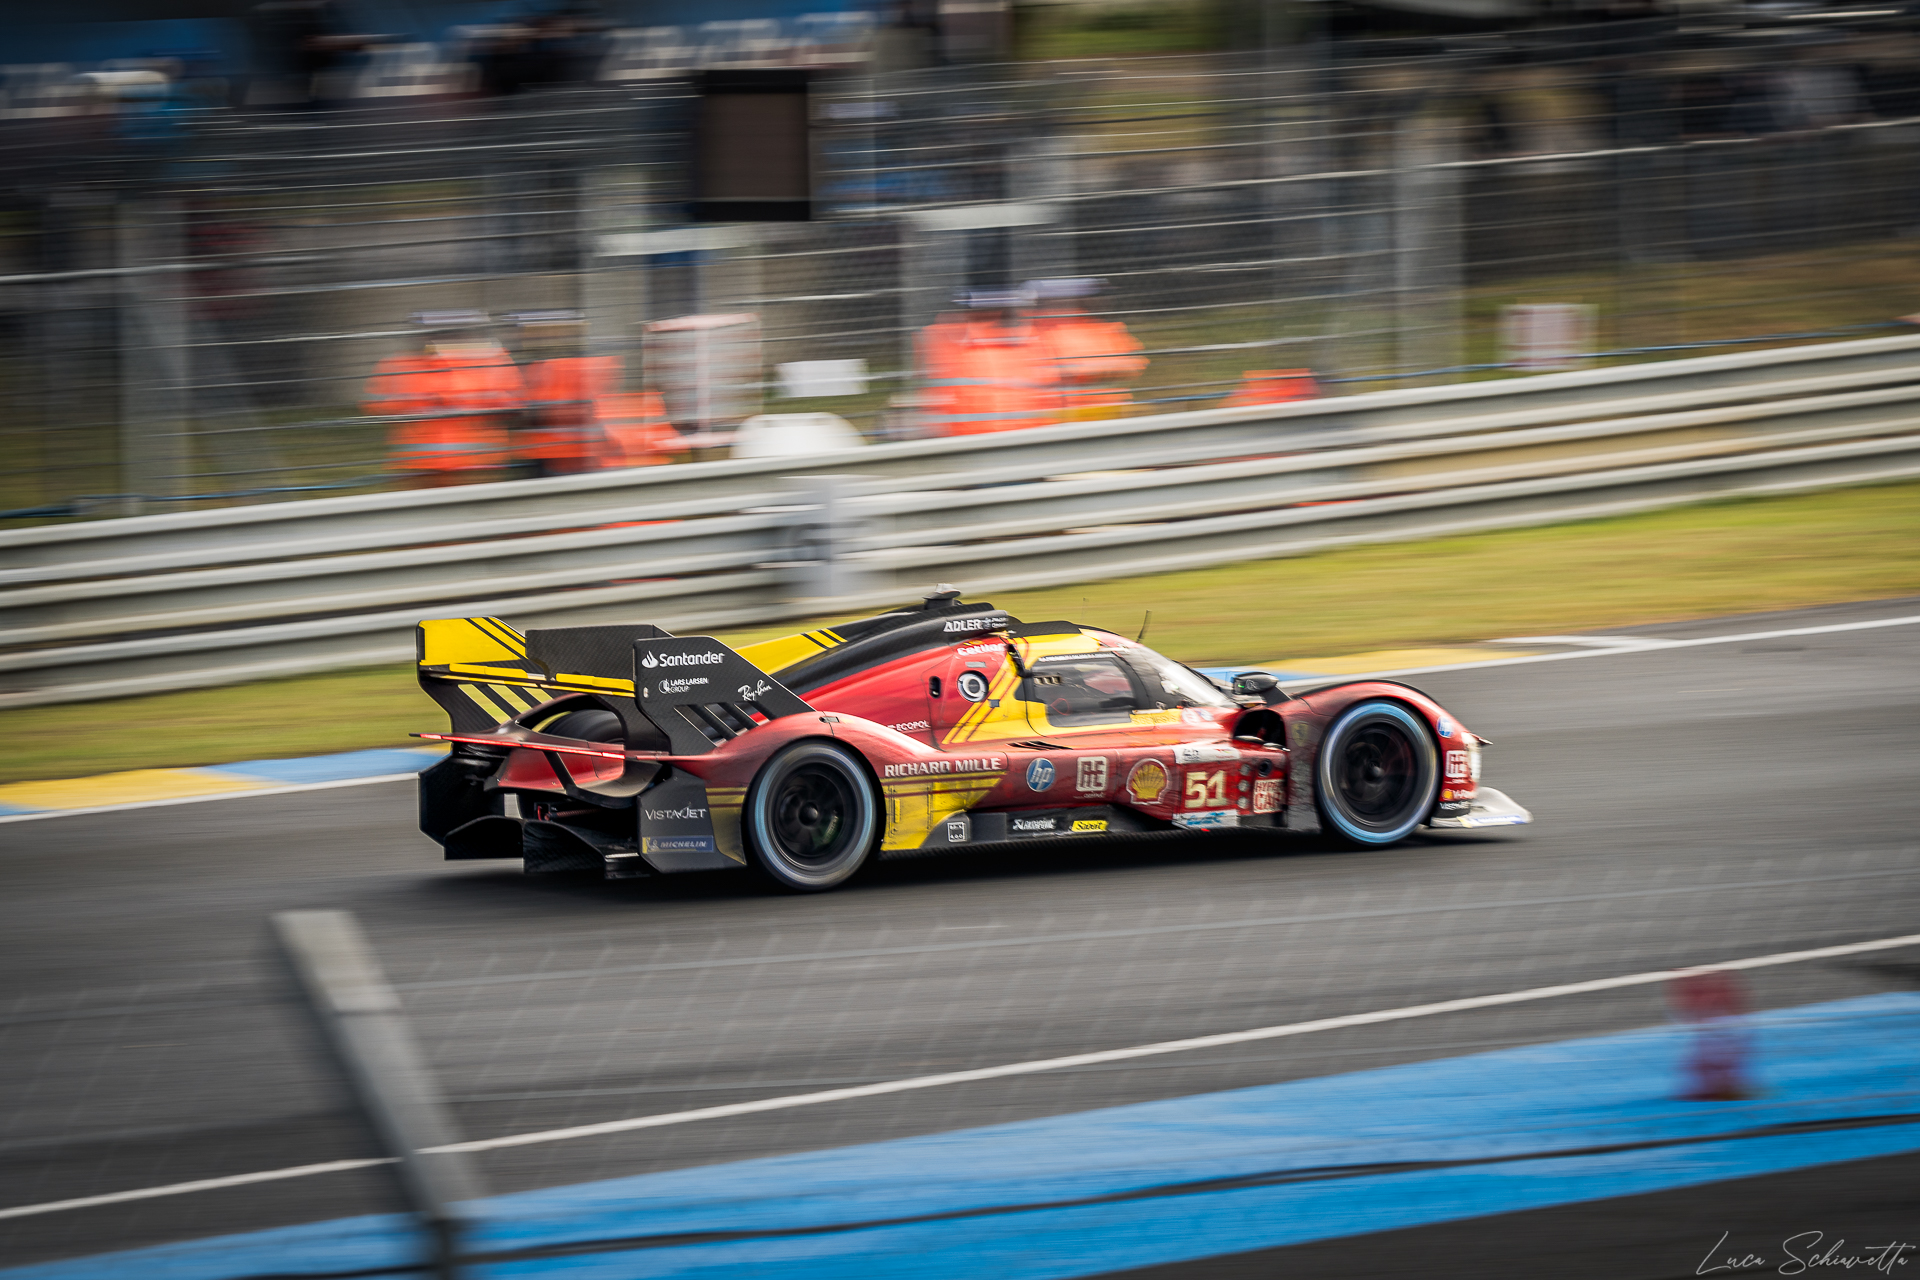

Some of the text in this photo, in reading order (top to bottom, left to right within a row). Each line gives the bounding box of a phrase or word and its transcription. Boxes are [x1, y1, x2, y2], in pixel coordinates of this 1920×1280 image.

[943, 619, 983, 632] ADLER
[659, 651, 725, 667] Santander
[685, 677, 709, 686] LARSEN
[670, 685, 690, 693] GROUP
[896, 720, 931, 731] ECOPOL
[884, 757, 1002, 777] RICHARD MILLE
[1029, 759, 1053, 791] hp
[1185, 770, 1228, 808] 51
[645, 806, 707, 820] VISTAJET
[660, 840, 707, 849] MICHELIN
